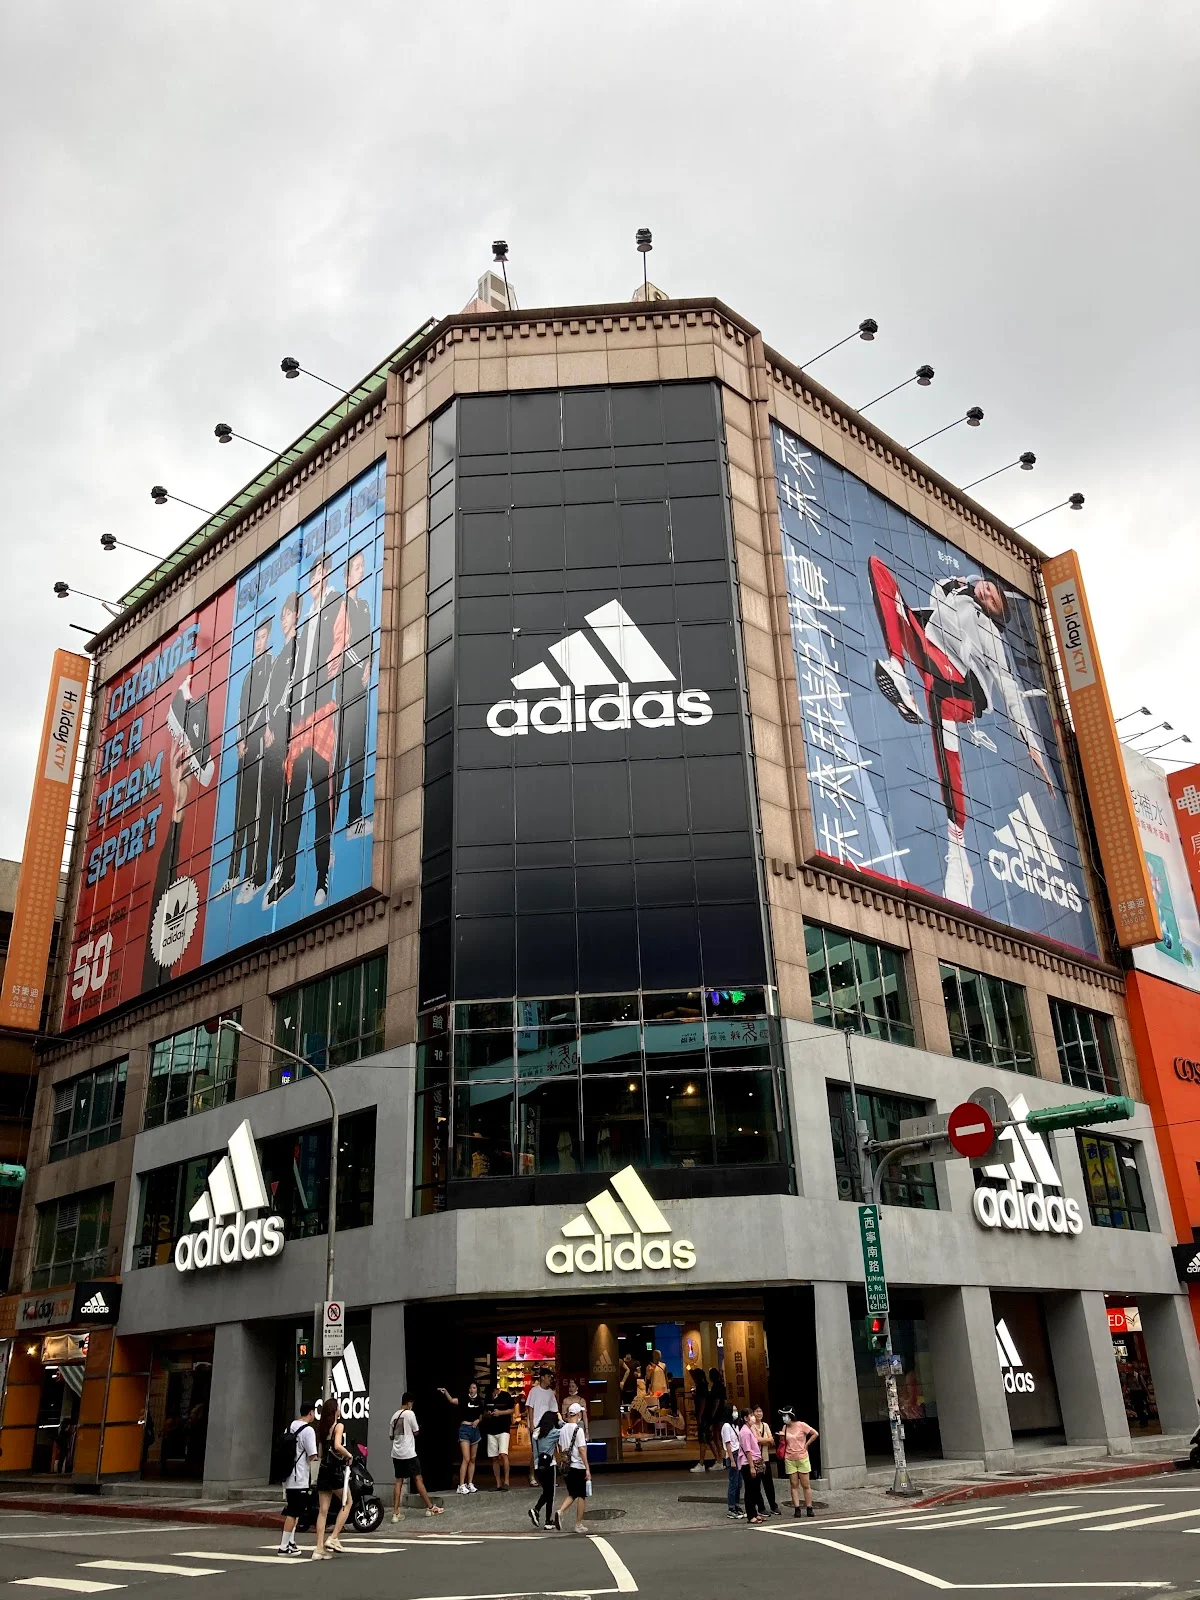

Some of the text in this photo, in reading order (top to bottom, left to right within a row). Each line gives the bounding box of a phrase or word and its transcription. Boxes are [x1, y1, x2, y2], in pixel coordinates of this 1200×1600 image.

[1061, 593, 1087, 674] Holiday KTV
[108, 622, 201, 723] CHANGE
[53, 690, 78, 771] Holiday KTV
[486, 683, 714, 737] adidas
[102, 715, 145, 776] IS A
[97, 750, 164, 828] TEAM
[86, 803, 163, 886] SPORT
[988, 849, 1083, 913] adidas
[71, 931, 114, 1001] 50
[162, 929, 186, 947] adidas
[974, 1178, 1083, 1235] adidas
[175, 1211, 285, 1272] adidas
[545, 1232, 697, 1274] adidas
[864, 1216, 880, 1273] 西寧南路
[80, 1305, 110, 1314] adidas
